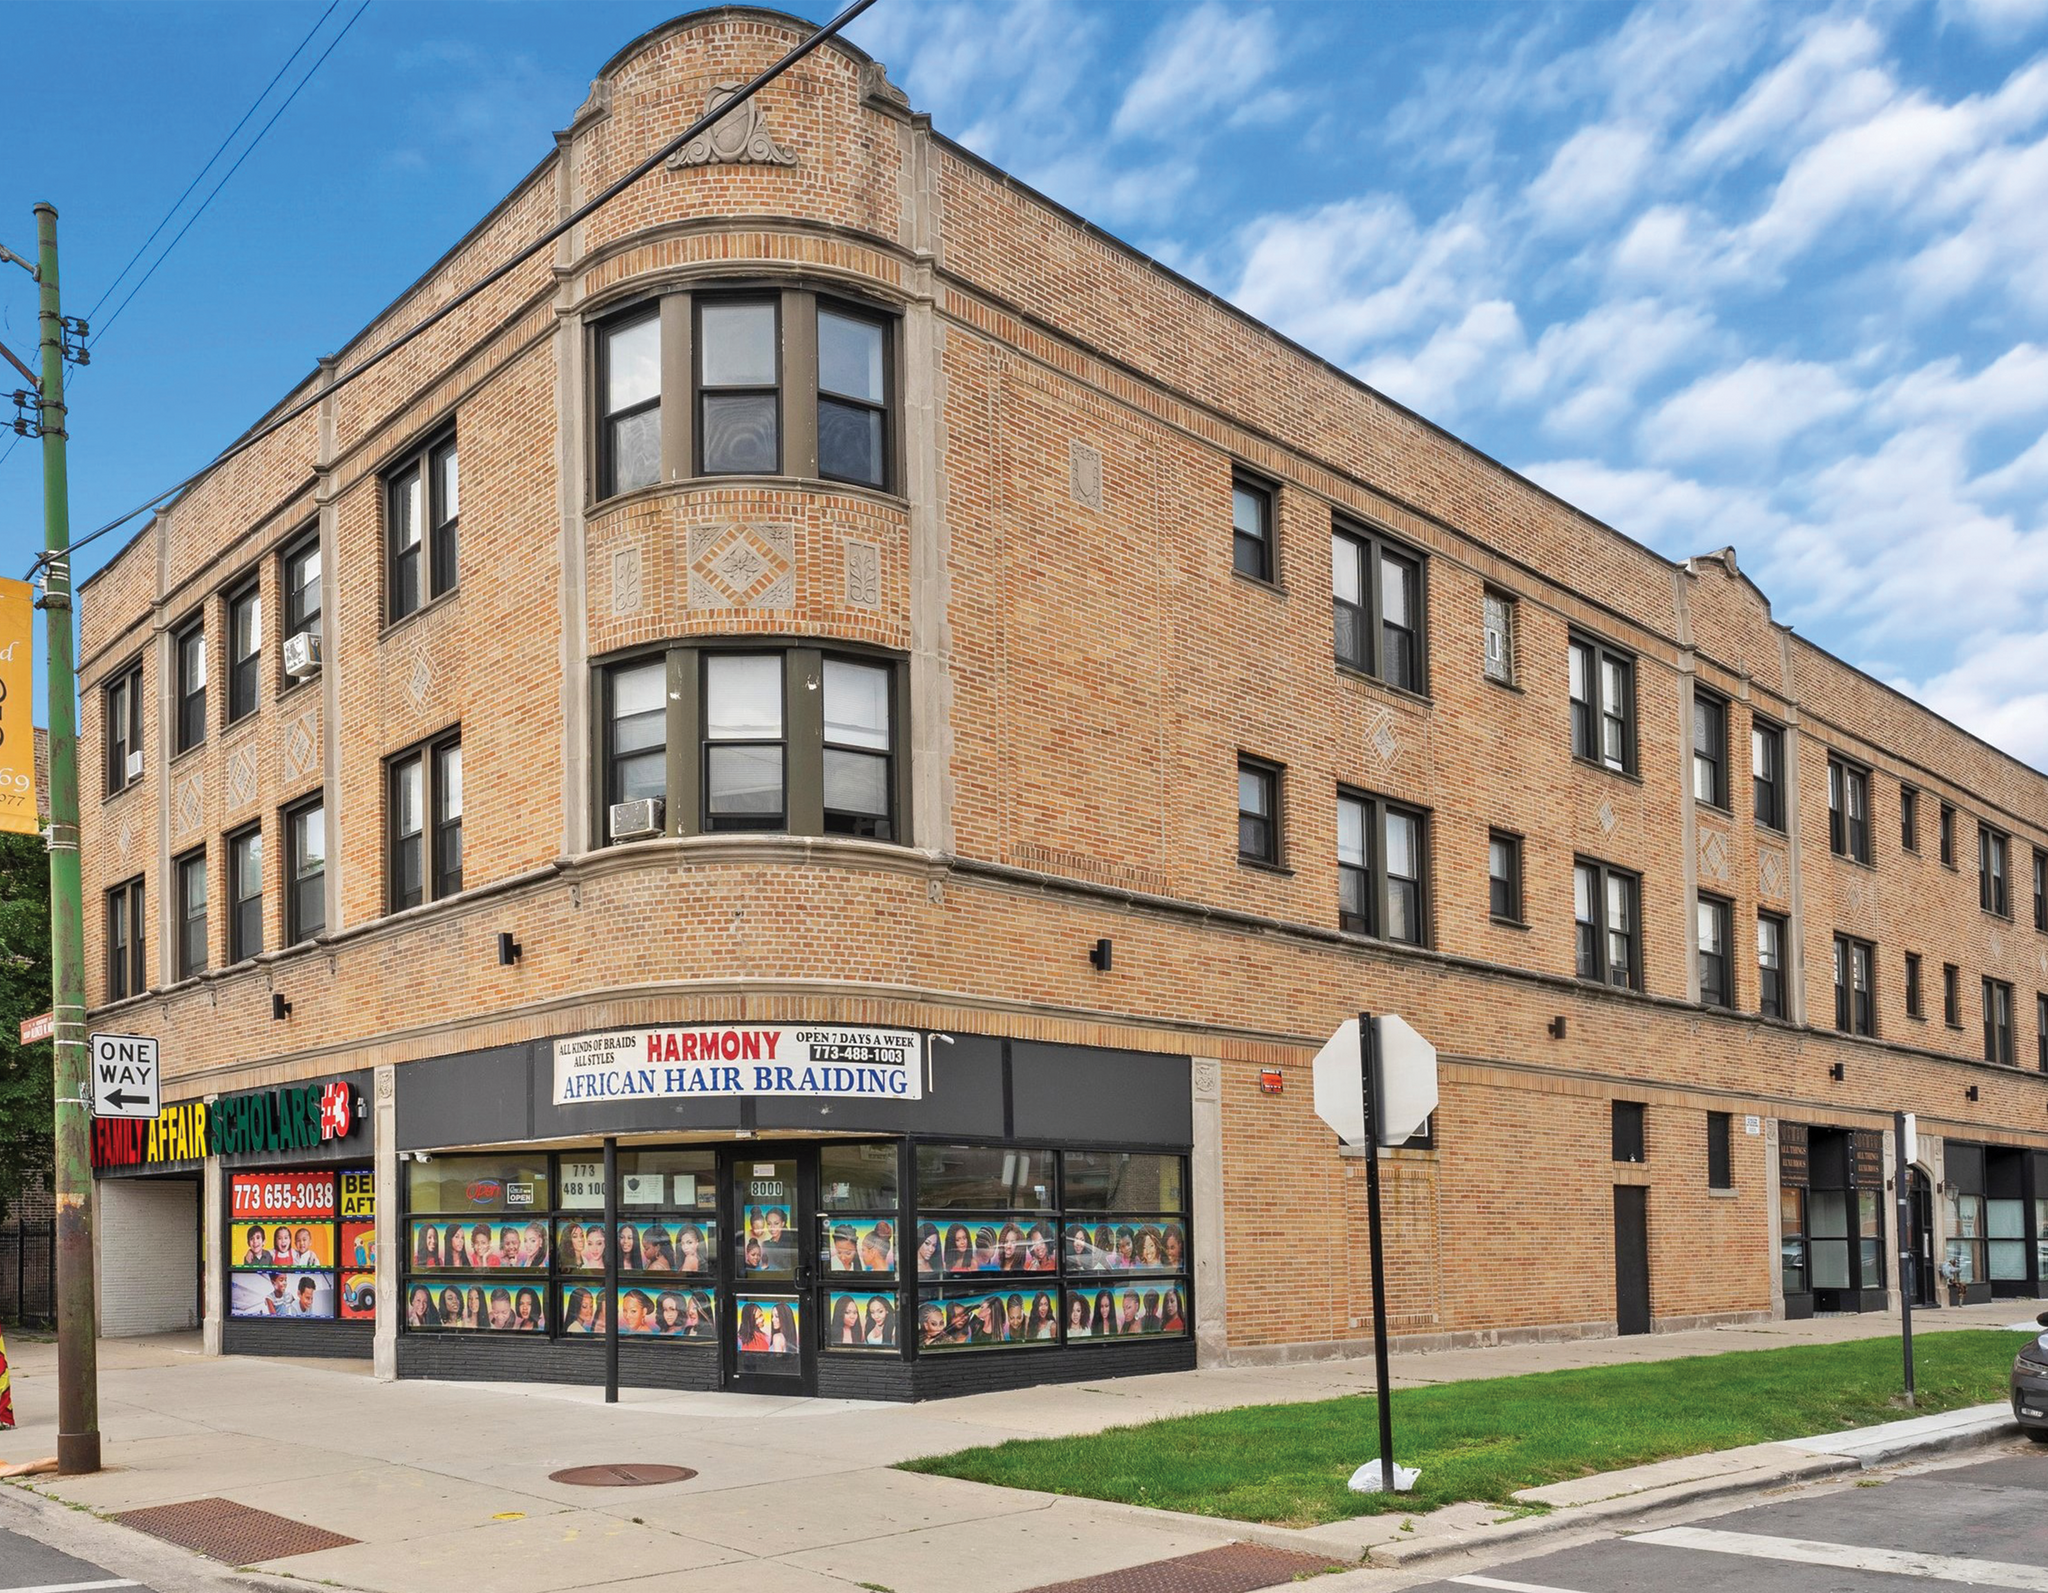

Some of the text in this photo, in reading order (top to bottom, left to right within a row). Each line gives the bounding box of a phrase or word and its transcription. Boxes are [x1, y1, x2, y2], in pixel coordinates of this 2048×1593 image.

[559, 1035, 636, 1056] ALL KINDS OF BRAIDS
[646, 1030, 782, 1063] HARMONY
[796, 1031, 915, 1048] OPEN 7 DAYS A WEEK
[100, 1042, 150, 1063] ONE
[574, 1052, 615, 1067] ALL STYLES
[813, 1045, 903, 1063] 773-488-1003
[99, 1064, 151, 1085] WAY
[563, 1066, 908, 1099] AFRICAN HAIR BRAIDING
[96, 1117, 144, 1167] FAMILY
[147, 1102, 208, 1162] AFFAIR
[211, 1084, 321, 1155] SCHOLARS
[321, 1081, 350, 1141] #3
[573, 1165, 595, 1177] 773
[234, 1182, 334, 1210] 773 655-3038
[466, 1182, 502, 1200] Open
[563, 1183, 583, 1195] 488
[752, 1182, 782, 1196] 8000
